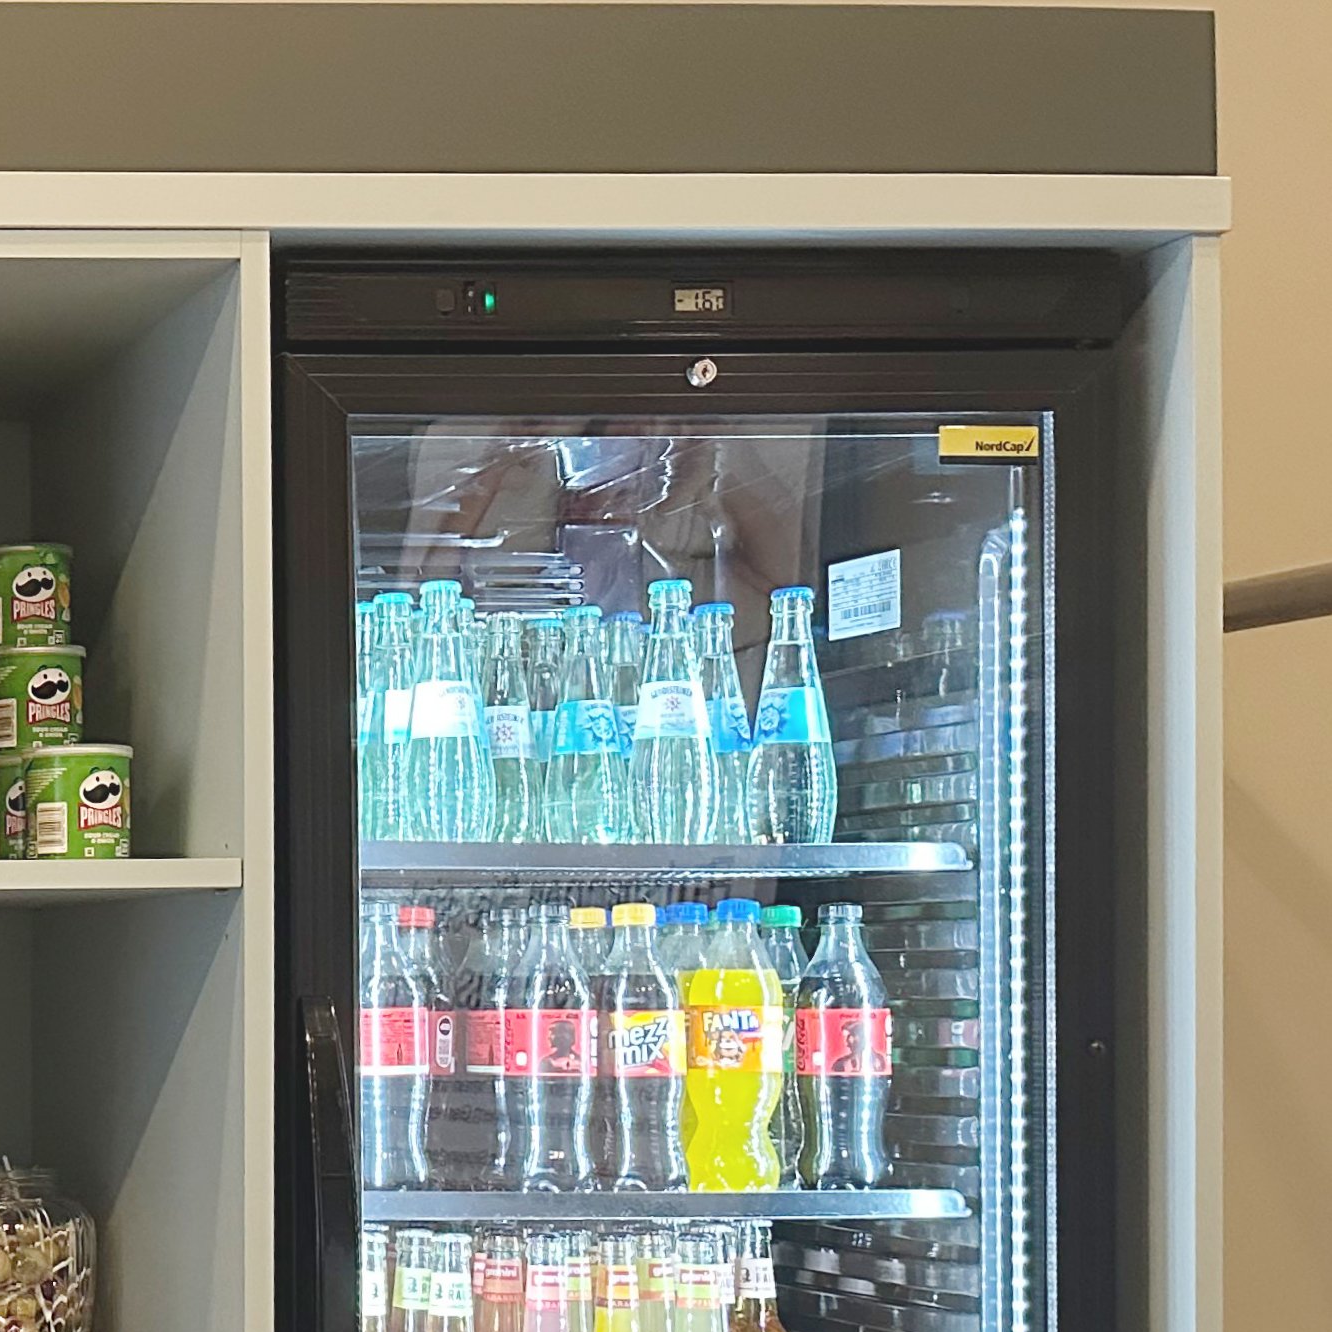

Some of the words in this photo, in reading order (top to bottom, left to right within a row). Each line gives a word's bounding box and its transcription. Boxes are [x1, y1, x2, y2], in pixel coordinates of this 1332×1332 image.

[976, 441, 1024, 454] NordCap
[13, 599, 56, 621] PRINGLES
[29, 701, 71, 723] PRINGLES
[80, 807, 122, 828] PRINGLES
[703, 1009, 760, 1032] FANTA
